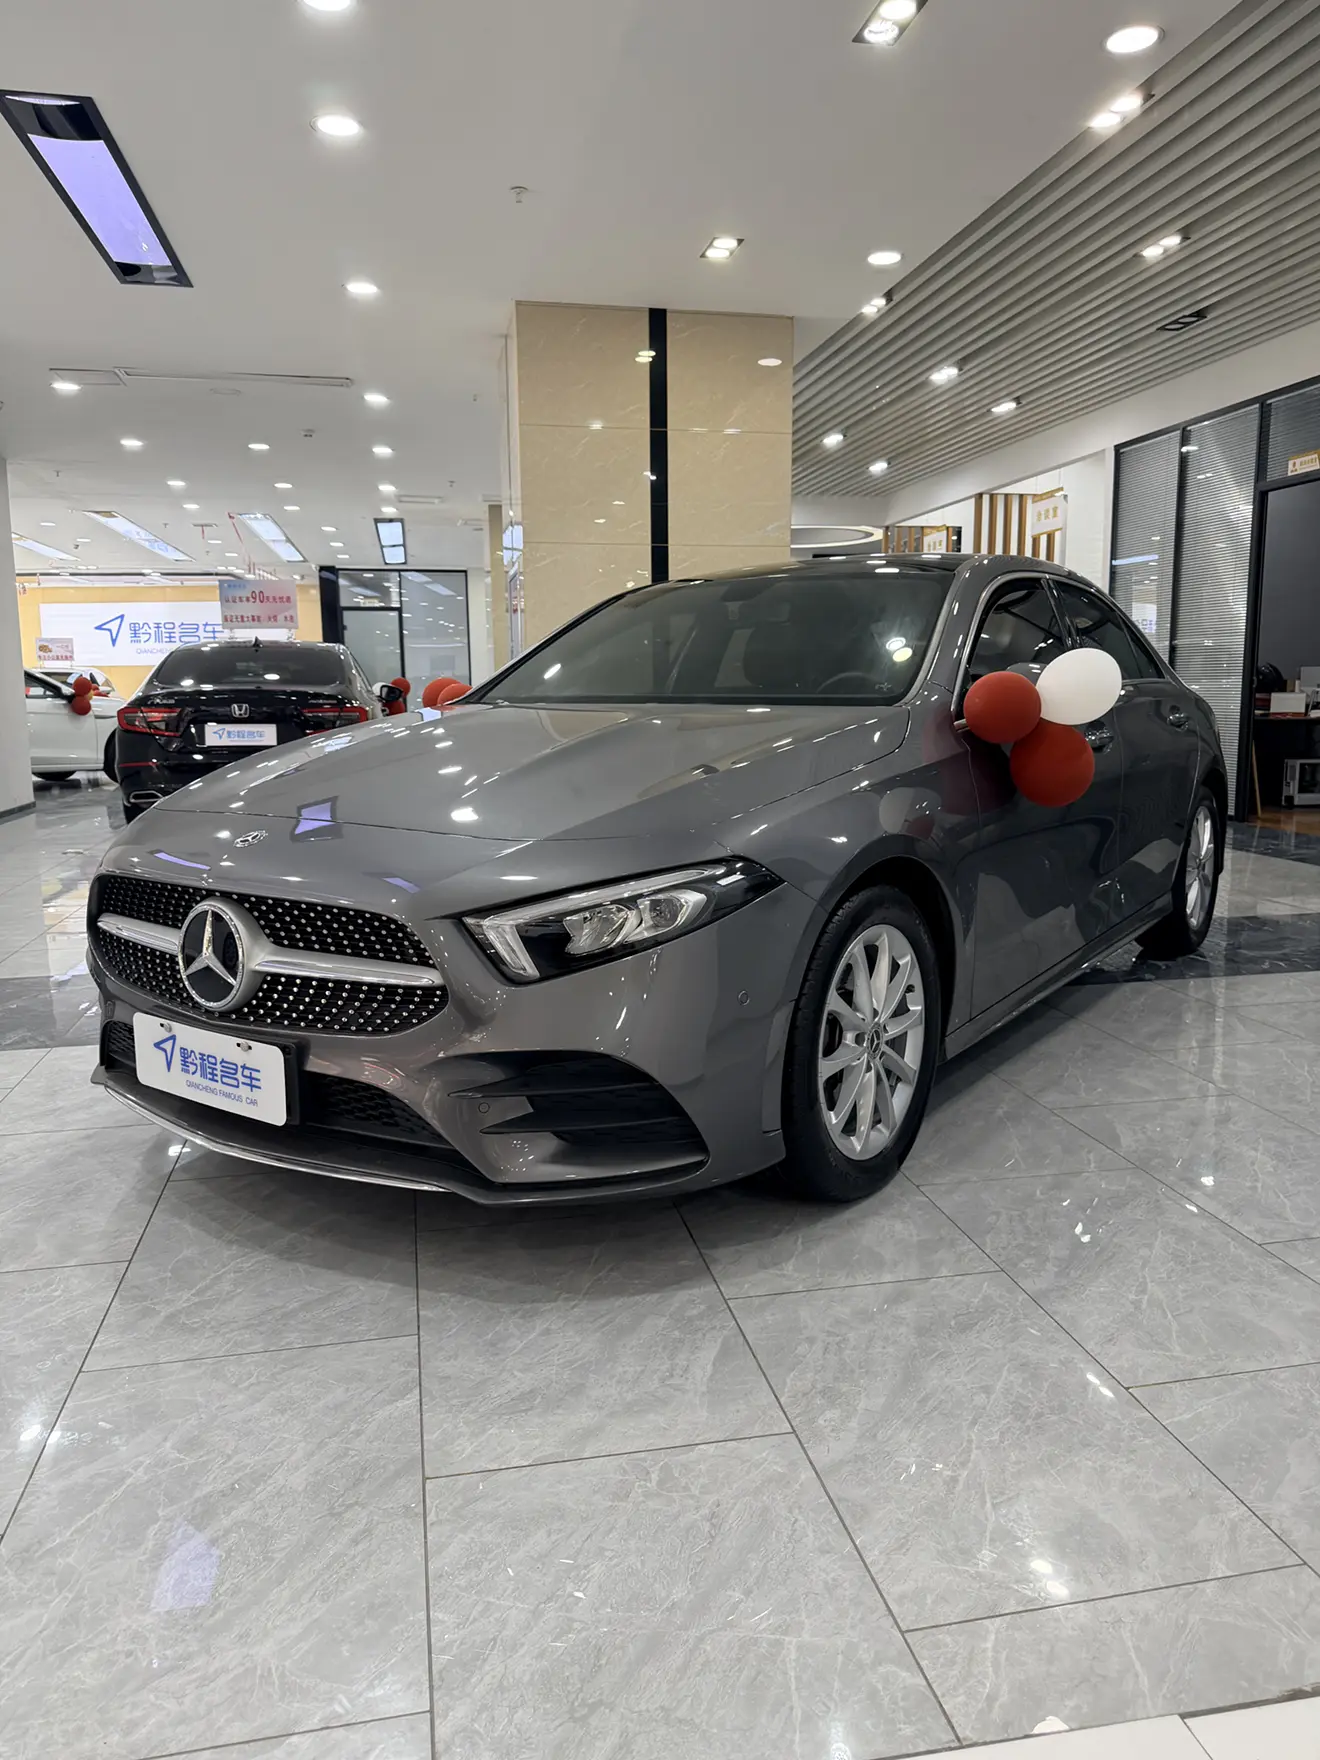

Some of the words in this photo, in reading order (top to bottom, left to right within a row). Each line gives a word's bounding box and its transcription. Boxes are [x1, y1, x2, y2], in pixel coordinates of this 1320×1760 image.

[128, 622, 225, 645] 黔程名车
[179, 1046, 262, 1093] 黔程名车
[185, 1079, 218, 1096] QIANCHENG
[218, 1089, 243, 1103] FAMOUS
[245, 1096, 259, 1107] CAR
